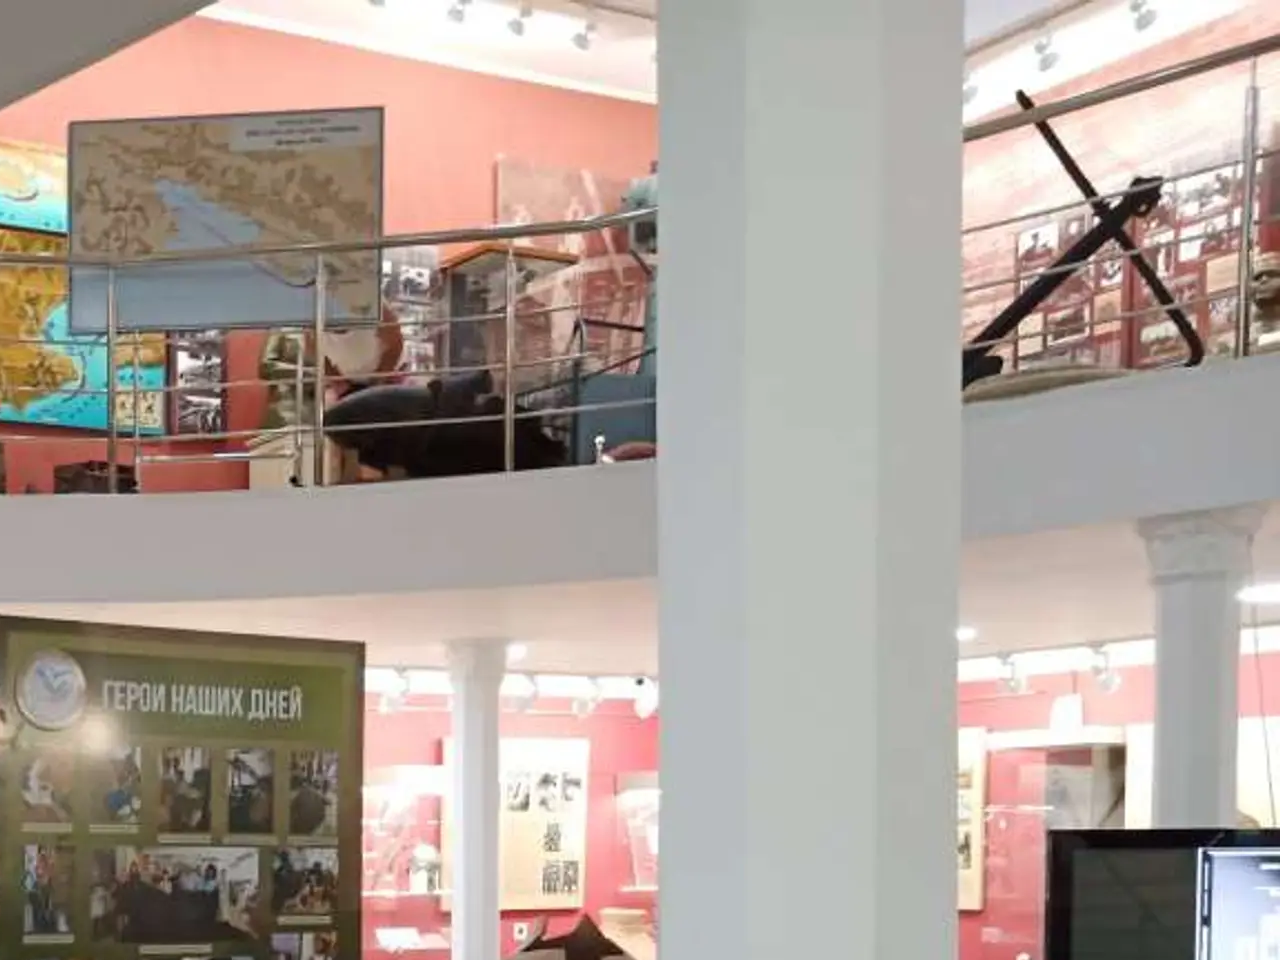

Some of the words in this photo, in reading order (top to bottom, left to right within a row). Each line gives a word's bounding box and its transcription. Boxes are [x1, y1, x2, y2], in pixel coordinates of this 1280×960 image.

[103, 680, 166, 713] ГЕРОИ
[171, 683, 244, 720] НАШИХ
[247, 685, 303, 722] ДНЕЙ
